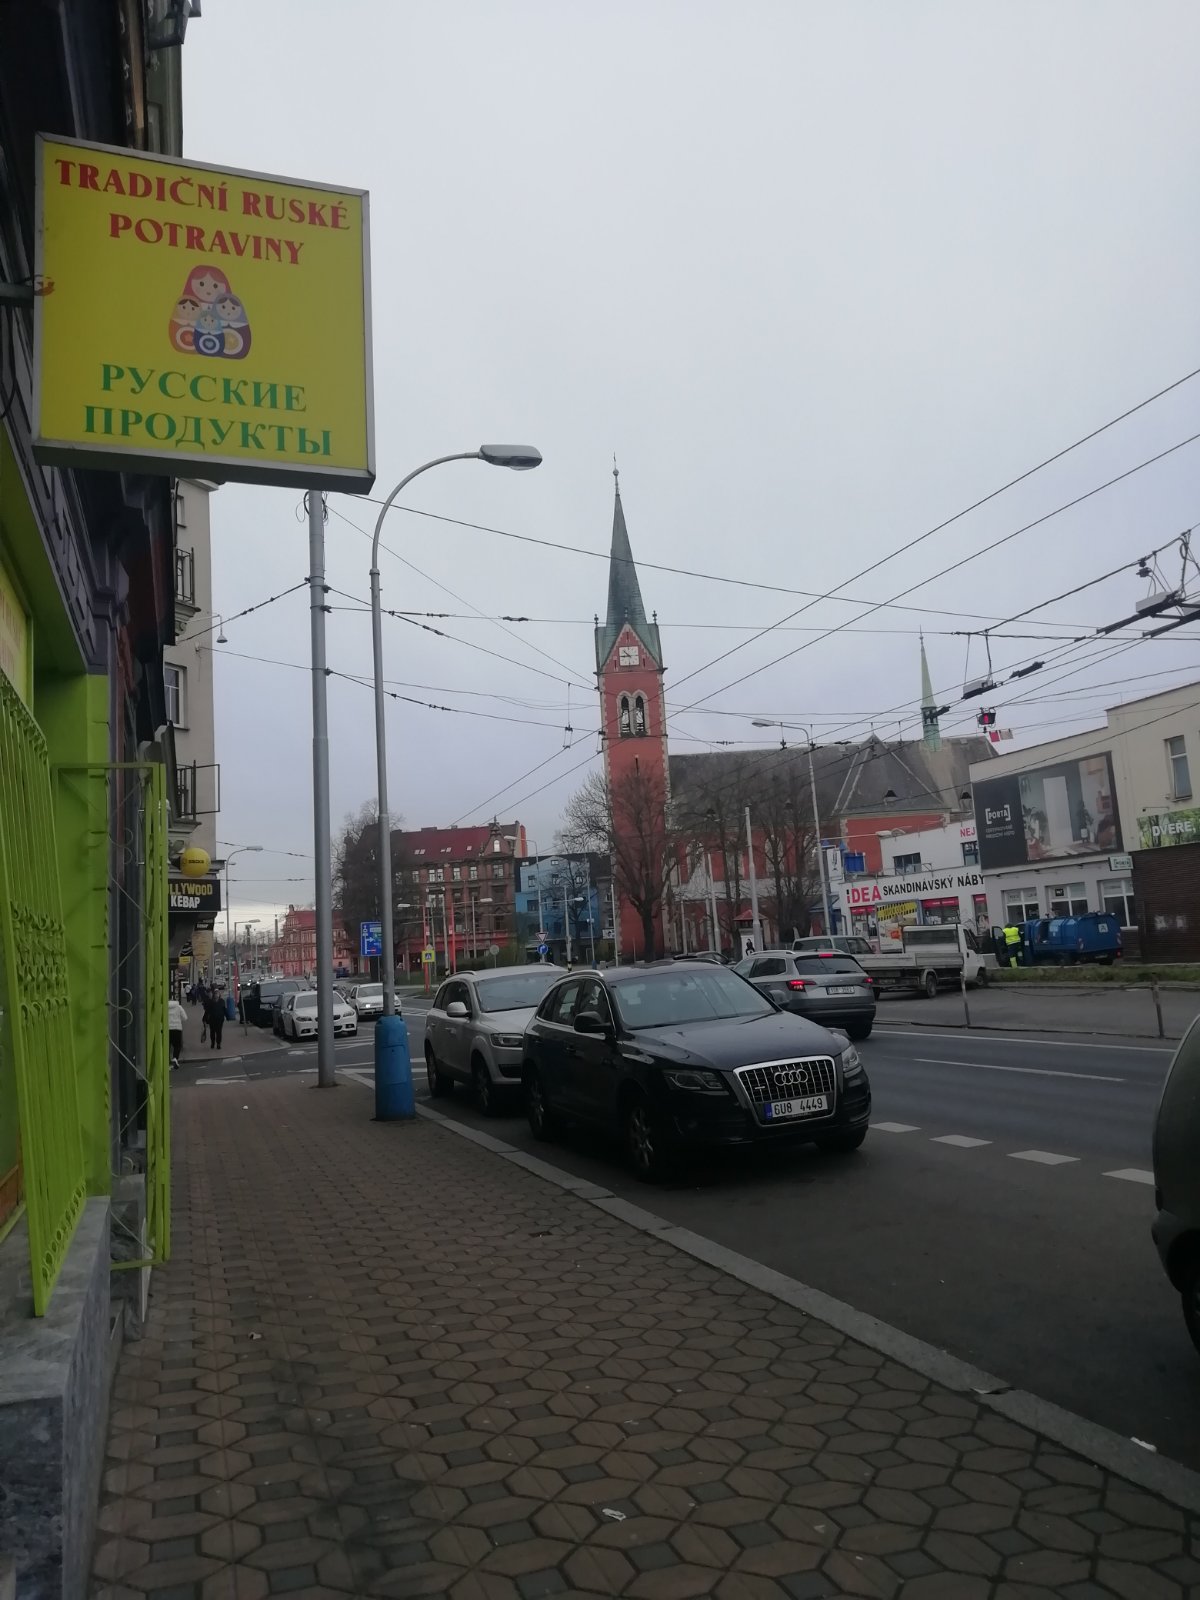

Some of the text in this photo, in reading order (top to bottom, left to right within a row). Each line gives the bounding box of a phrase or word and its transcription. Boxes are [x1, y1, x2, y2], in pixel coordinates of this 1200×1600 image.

[55, 159, 350, 231] TRADIČNÍ RUSKÉ
[109, 213, 304, 265] POTRAVINY
[100, 363, 307, 413] РУССКИЕ
[84, 405, 332, 457] ПРОДУКТЫ
[168, 882, 213, 896] LLYWOOD
[171, 895, 200, 909] KEBAP
[883, 875, 954, 896] SKANDINÁVSKÝ
[957, 872, 985, 887] NÁBY
[774, 1102, 792, 1115] 6U8
[800, 1097, 823, 1111] 4449
